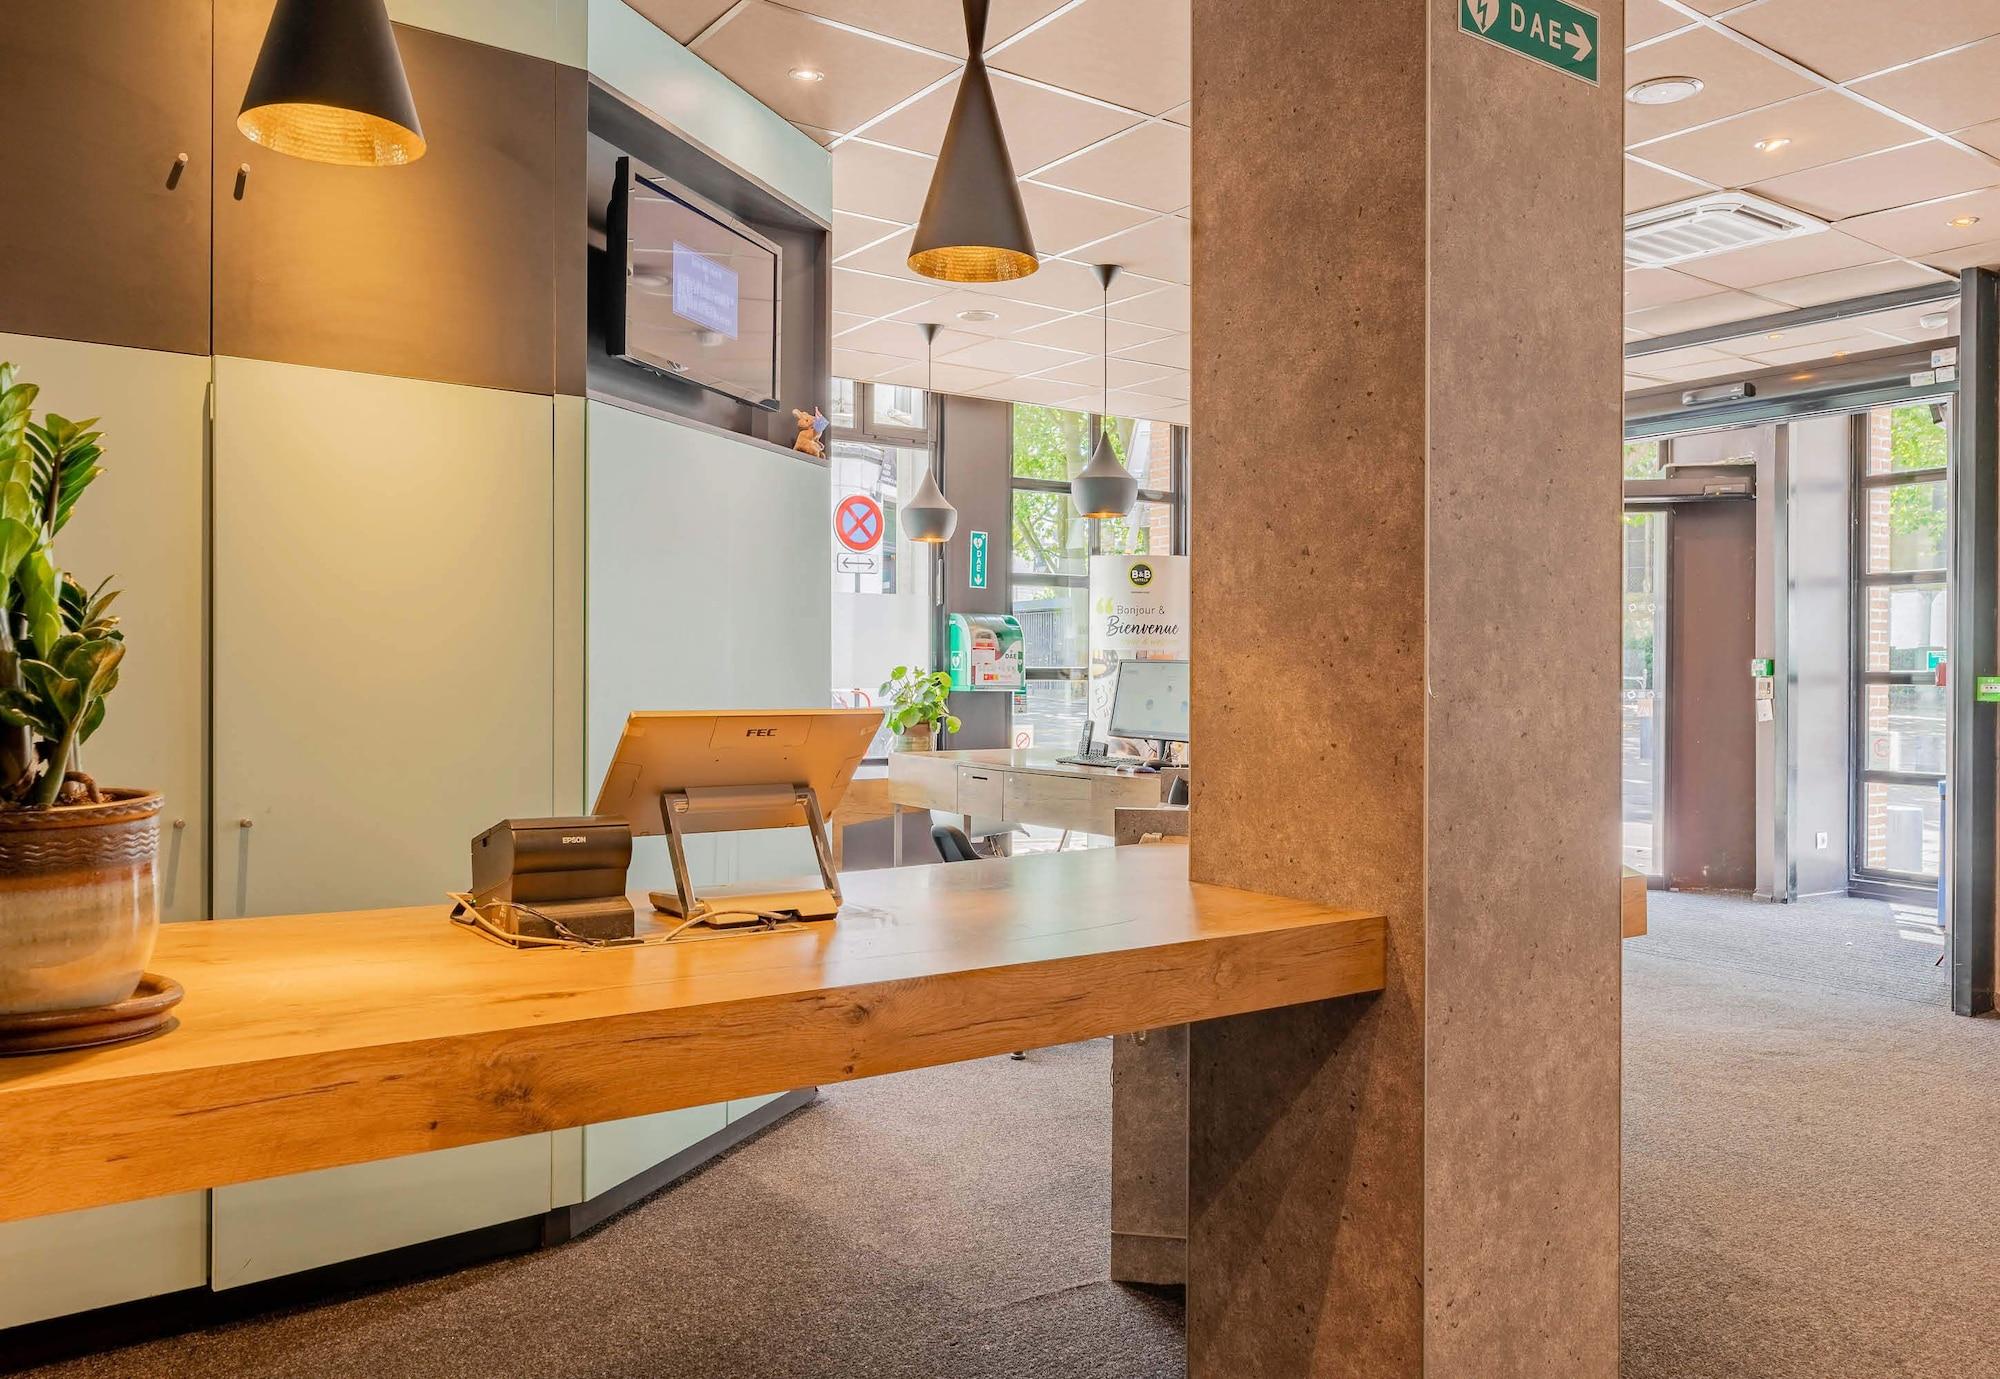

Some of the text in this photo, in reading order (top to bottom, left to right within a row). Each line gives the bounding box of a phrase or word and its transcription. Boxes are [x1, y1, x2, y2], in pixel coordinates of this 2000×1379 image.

[1511, 2, 1562, 50] DAE
[1131, 569, 1151, 579] B&B
[1116, 605, 1165, 616] Bonjour &
[1106, 615, 1179, 637] Bienvenue
[746, 728, 778, 737] FEC
[562, 836, 587, 844] EPSON
